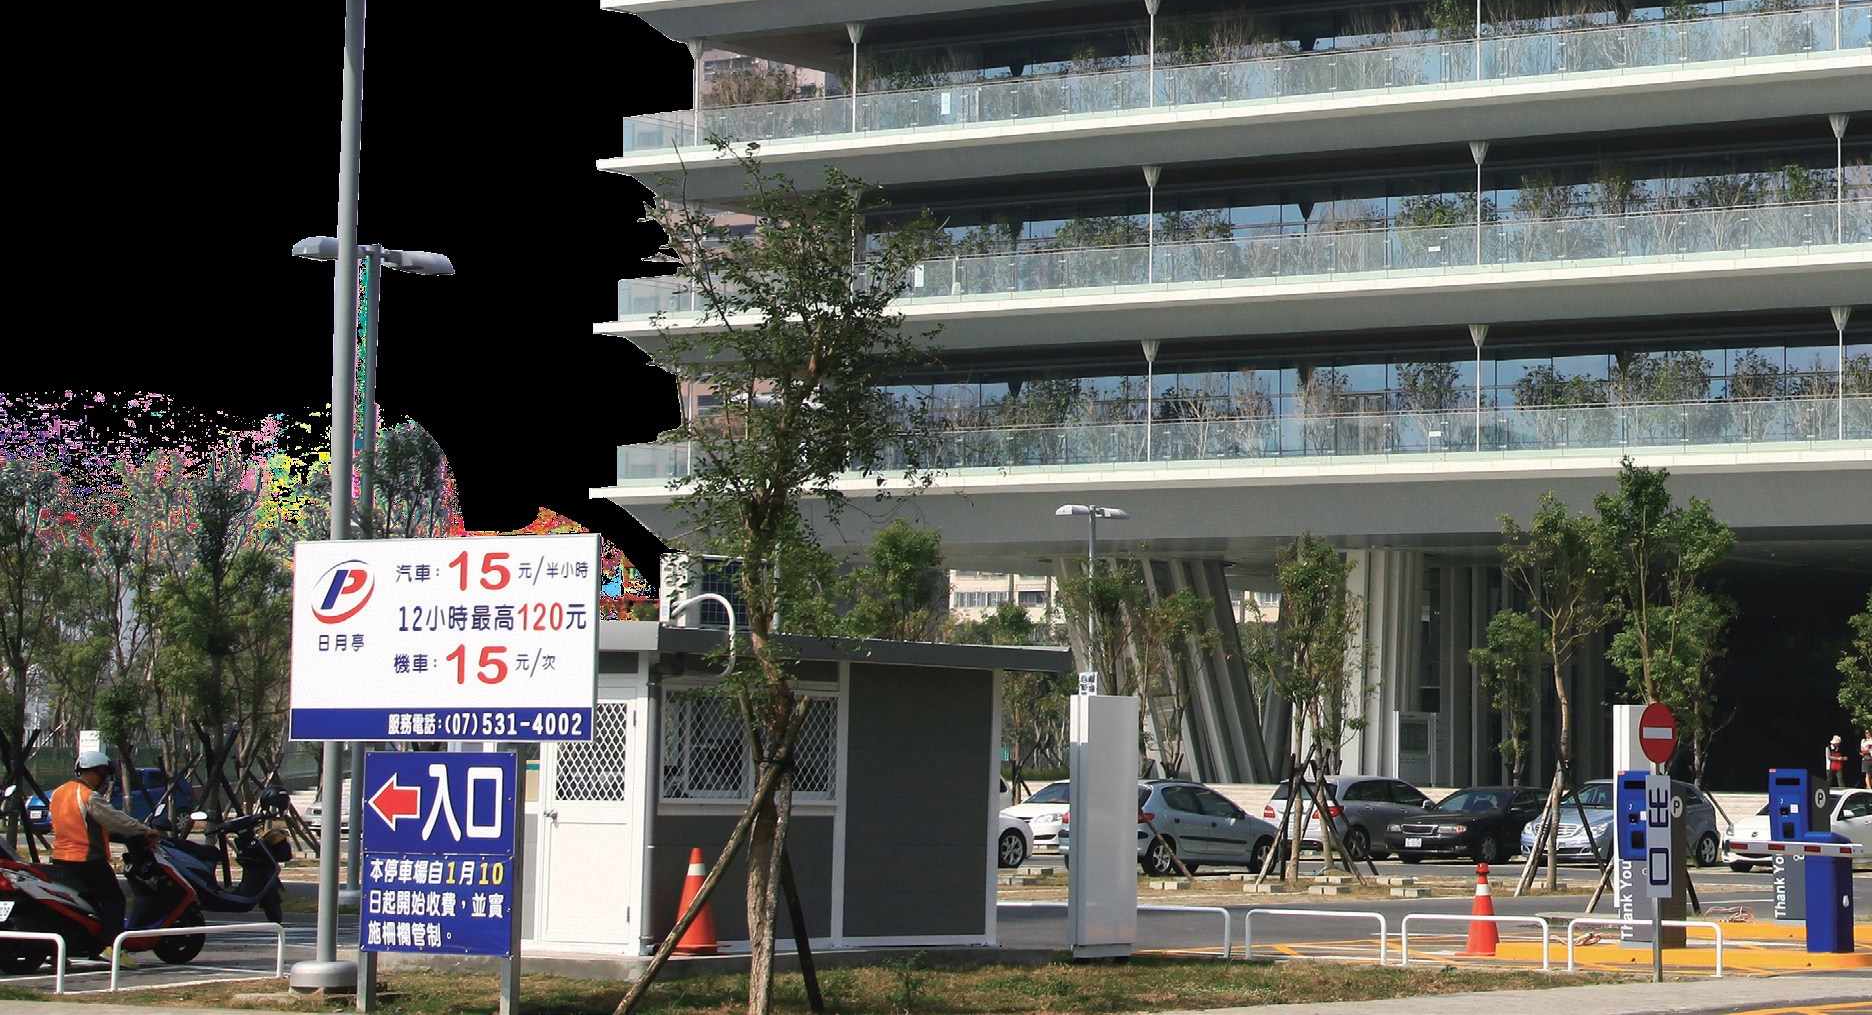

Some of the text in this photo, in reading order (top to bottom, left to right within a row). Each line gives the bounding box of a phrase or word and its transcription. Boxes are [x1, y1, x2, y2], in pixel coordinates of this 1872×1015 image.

[399, 602, 587, 632] 12小時最高120元
[318, 634, 365, 652] 日月亭
[421, 764, 504, 842] 入口
[1649, 787, 1670, 886] 出口
[1619, 860, 1633, 889] You
[1774, 877, 1787, 919] Thank
